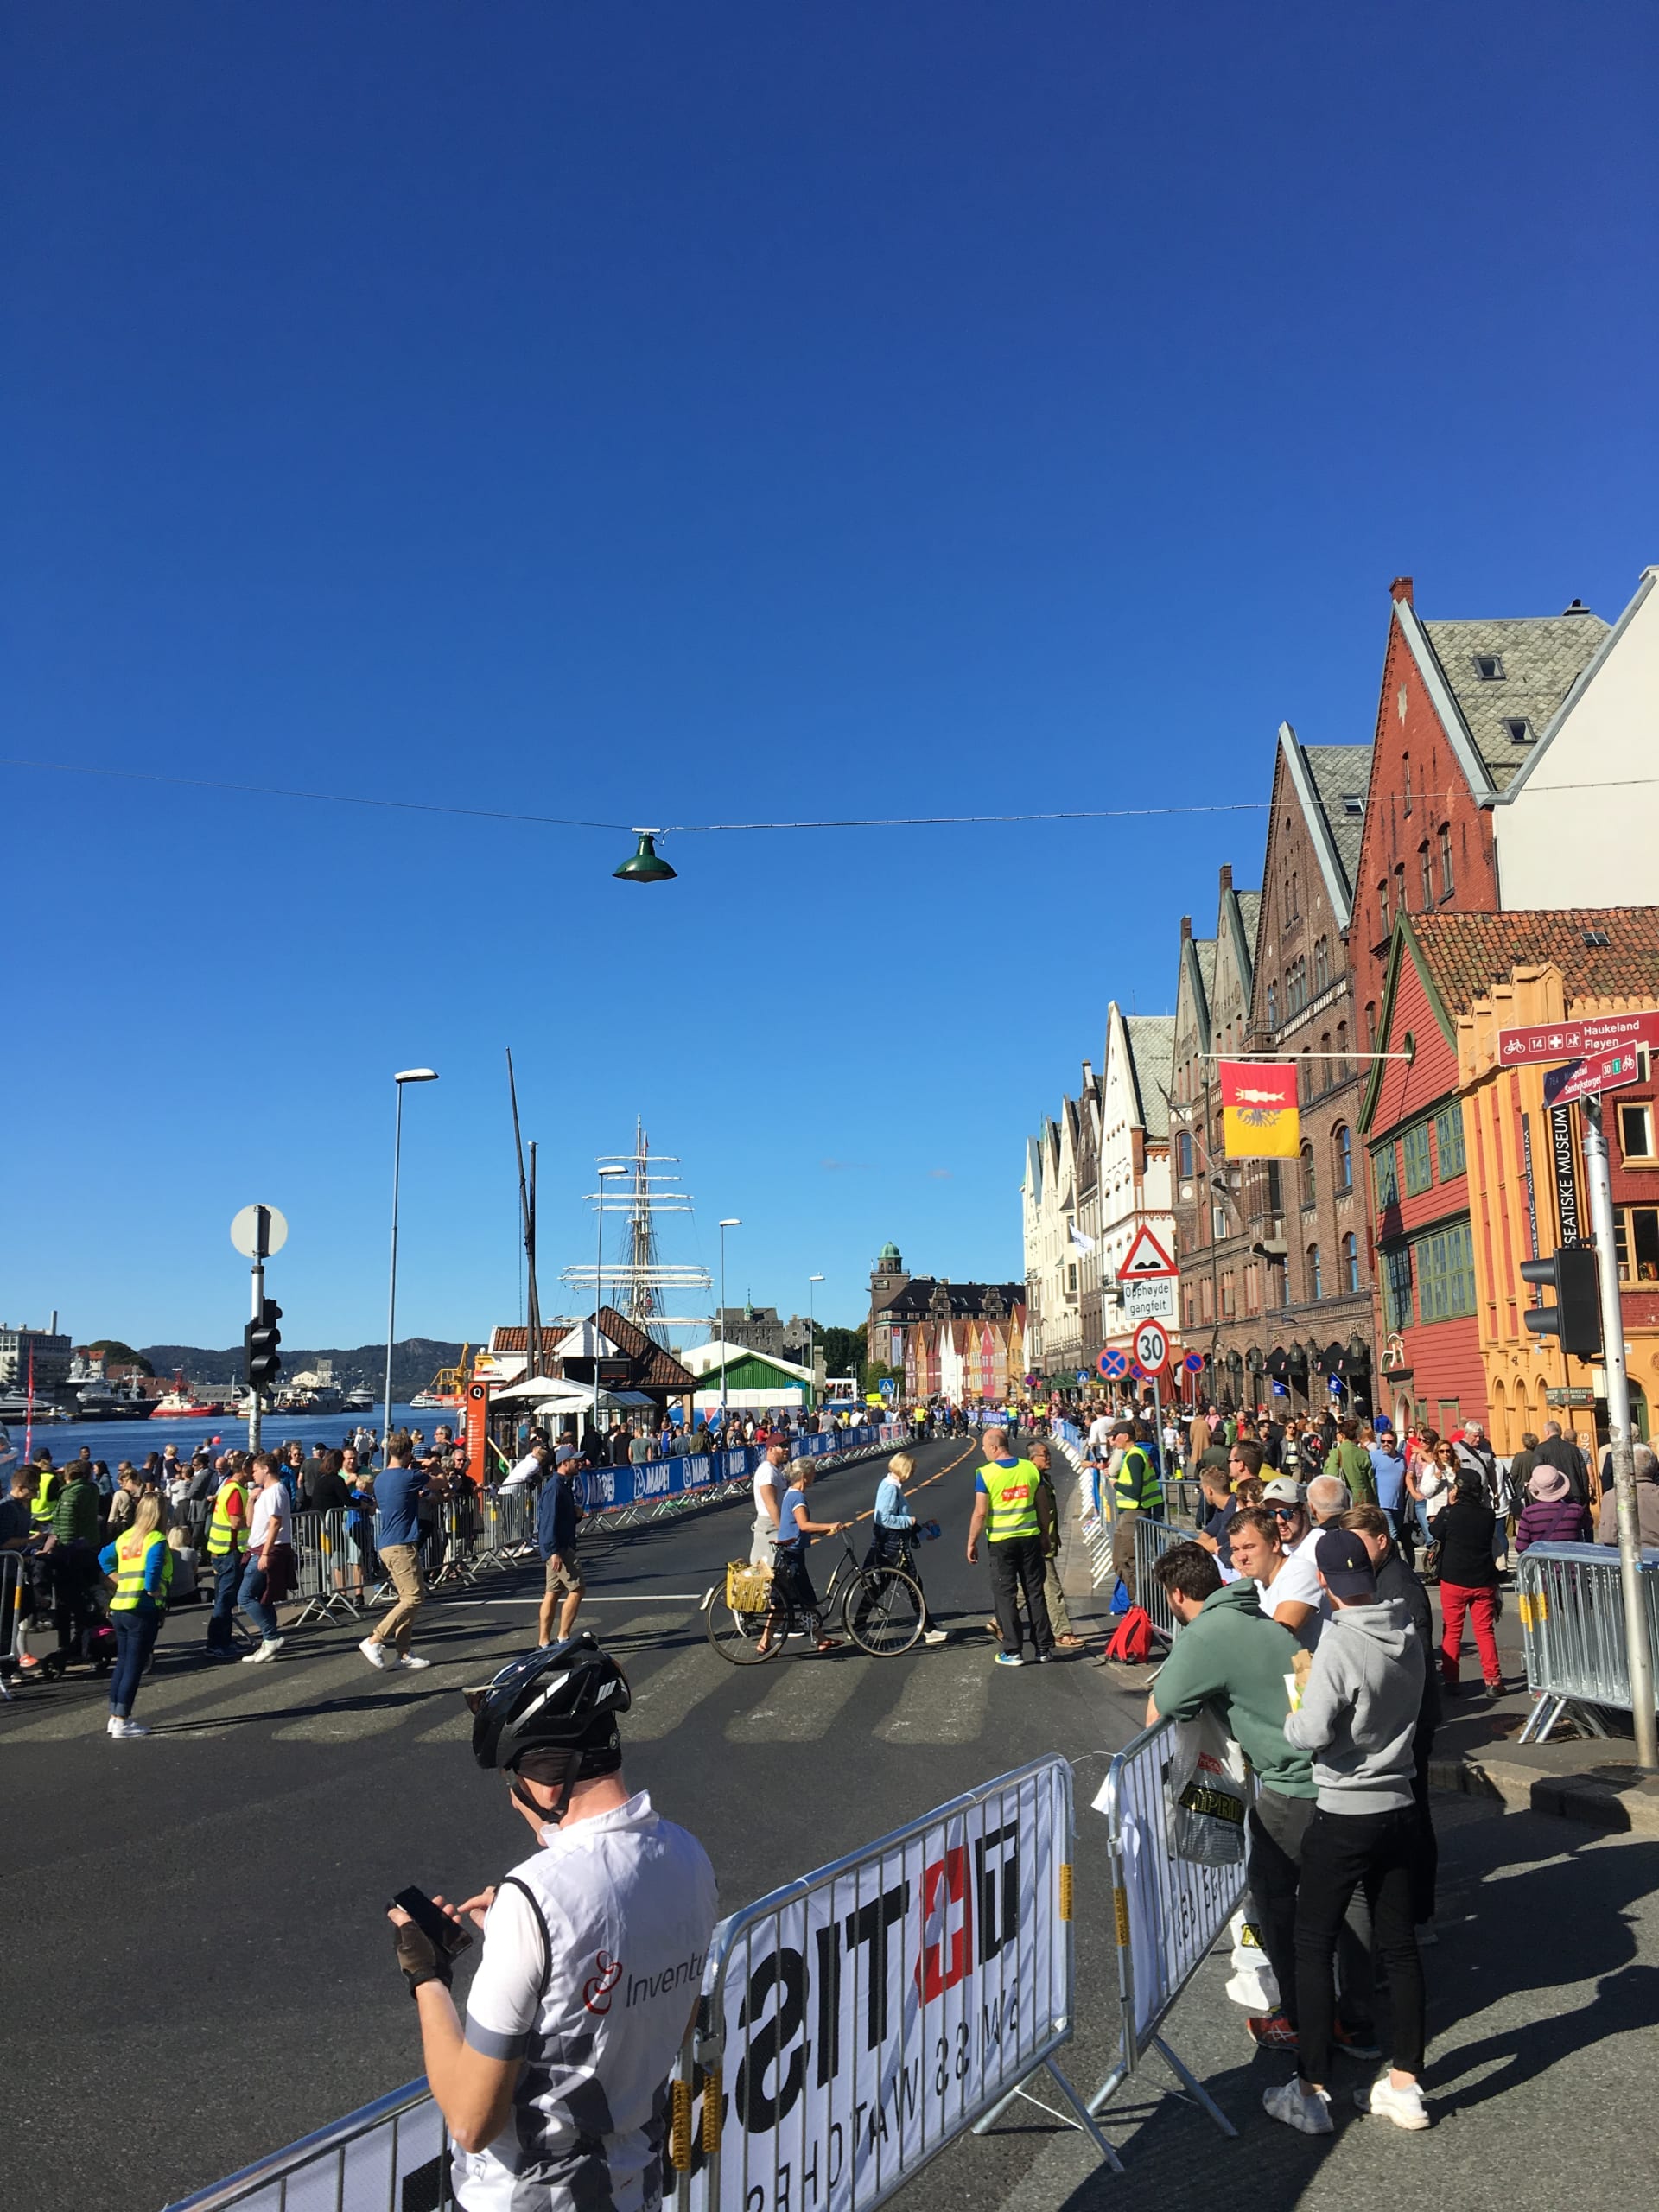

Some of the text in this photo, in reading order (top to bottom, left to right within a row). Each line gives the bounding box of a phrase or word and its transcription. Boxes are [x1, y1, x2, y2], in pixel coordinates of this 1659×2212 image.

[1532, 1020, 1640, 1049] 14 Haukeland
[1585, 1039, 1619, 1051] Fløyen
[1603, 1064, 1611, 1076] 30
[1554, 1109, 1577, 1246] SEATISKE MUSEUM
[1524, 1129, 1539, 1260] NSEATIC MUSEUM
[1125, 1283, 1169, 1299] Opphøyde
[1130, 1300, 1167, 1316] gangfelt
[1140, 1333, 1164, 1362] 30
[473, 1387, 481, 1398] Q
